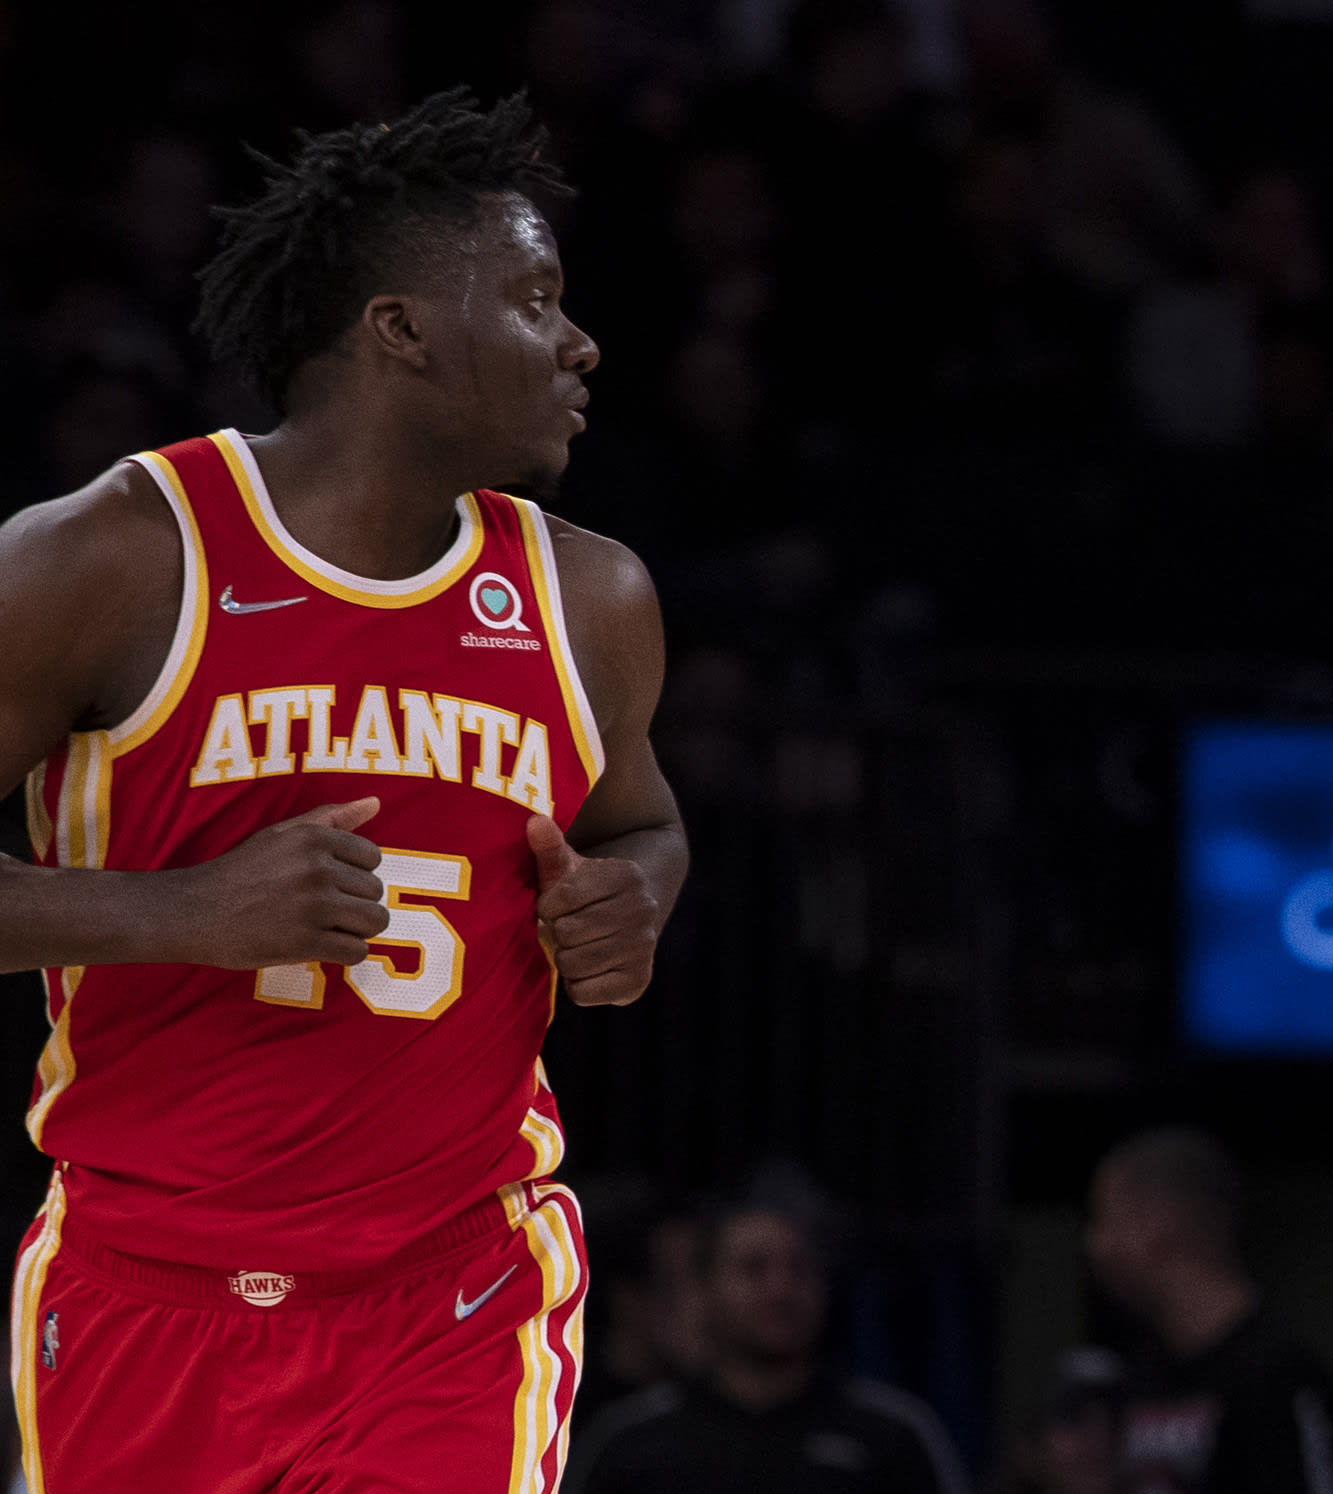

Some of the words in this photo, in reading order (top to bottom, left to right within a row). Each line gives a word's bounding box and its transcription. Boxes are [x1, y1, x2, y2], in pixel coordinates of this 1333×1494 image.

[460, 632, 541, 651] sharecare
[190, 684, 554, 817] ATLANTA
[253, 848, 471, 1020] 5
[229, 1276, 294, 1293] HAWKS
